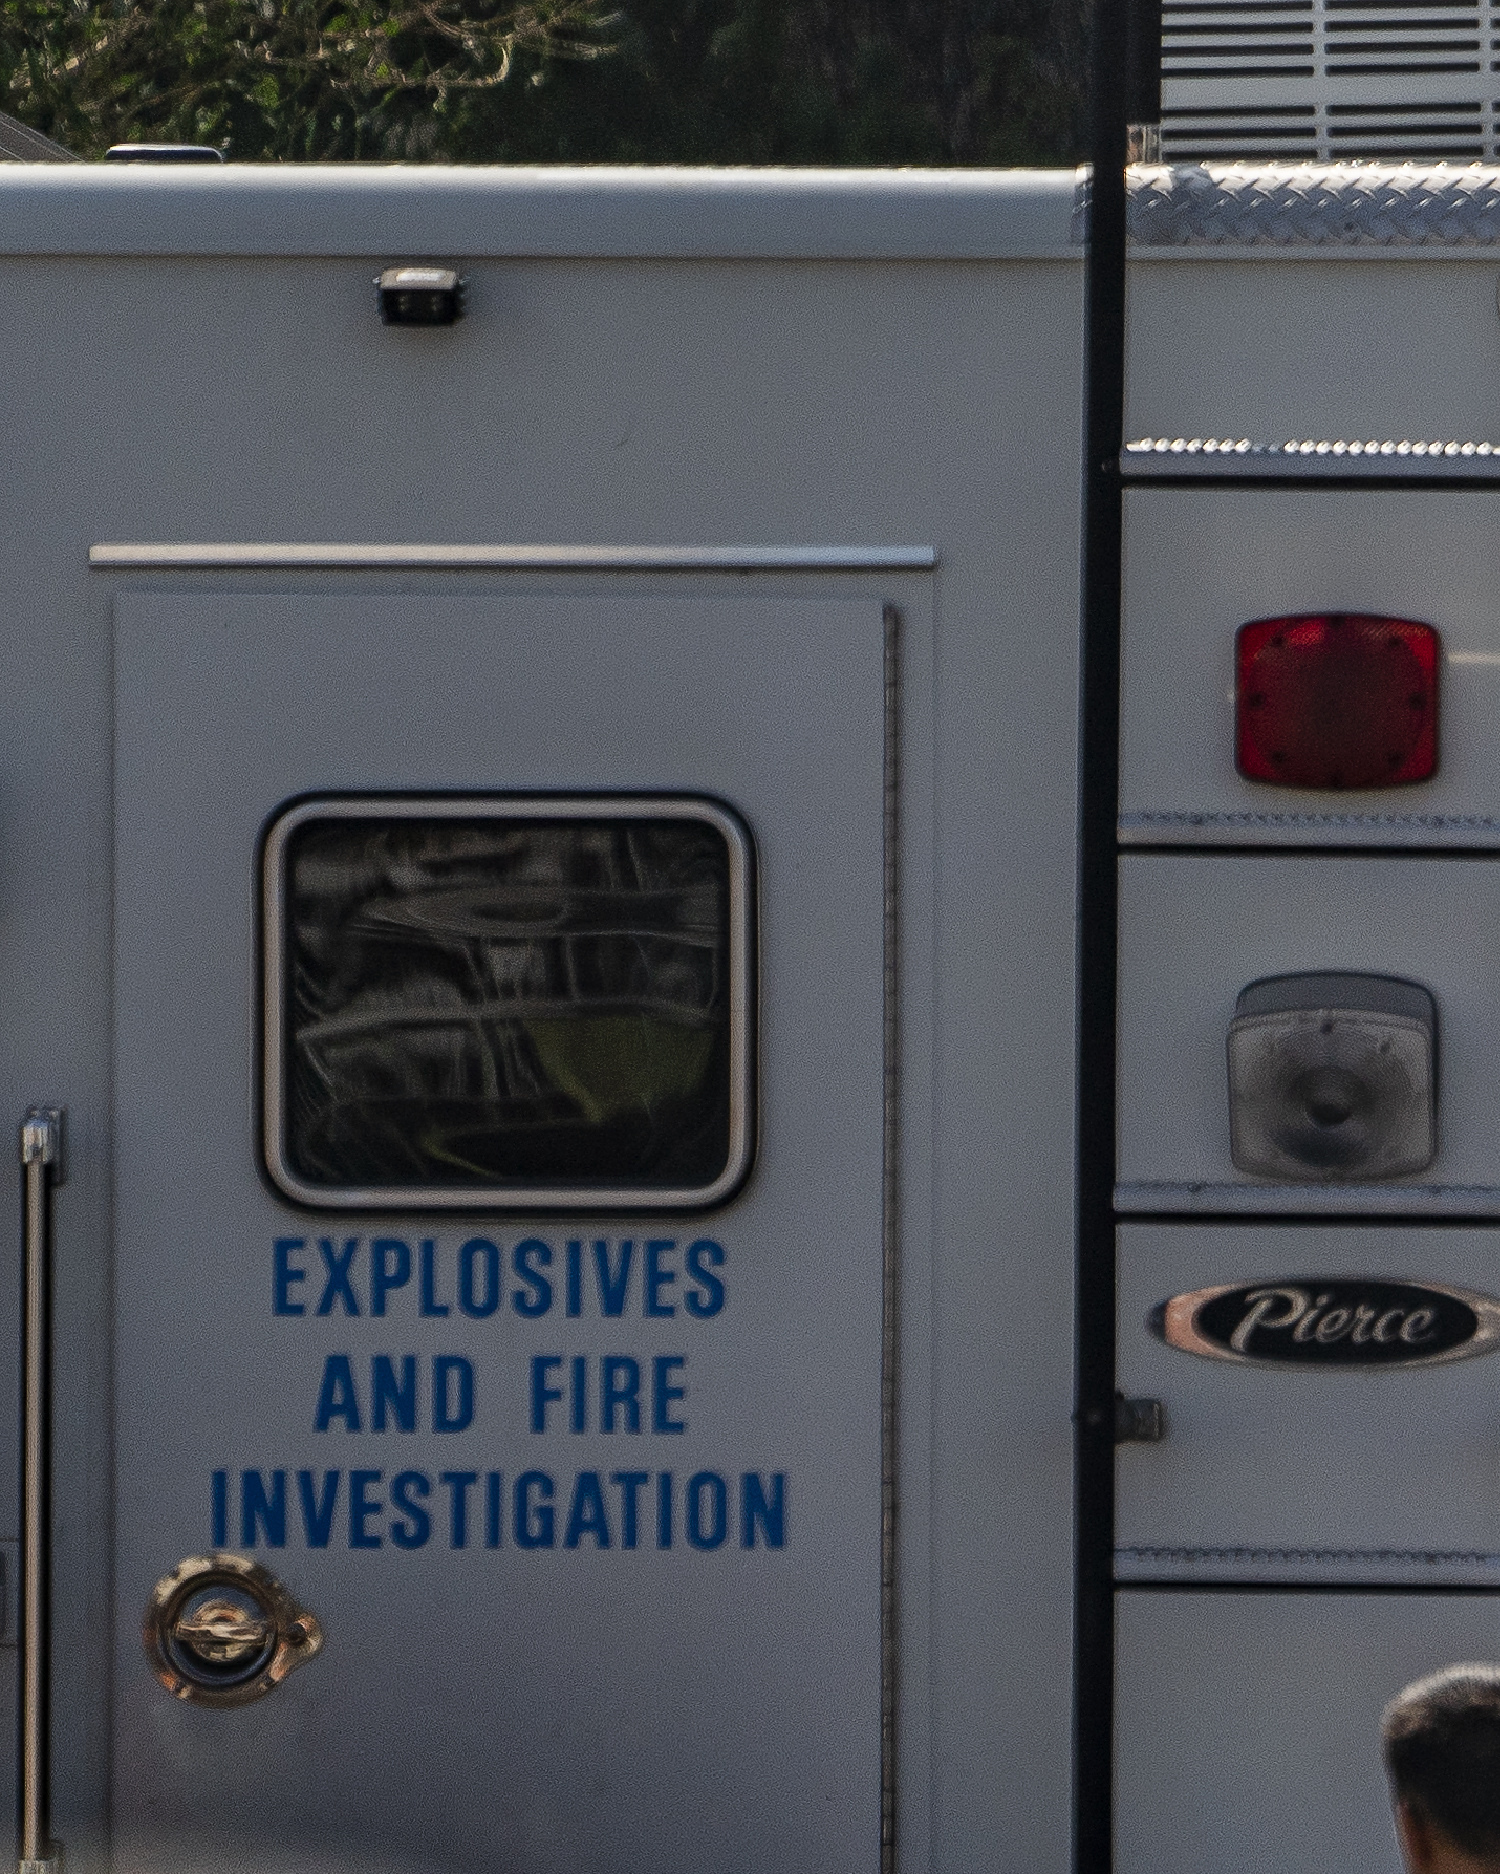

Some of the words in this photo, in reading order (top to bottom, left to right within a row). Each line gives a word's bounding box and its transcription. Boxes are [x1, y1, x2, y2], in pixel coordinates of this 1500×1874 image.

[271, 1236, 727, 1319] EXPLOSIVES
[1230, 1286, 1434, 1351] Pierce
[312, 1354, 476, 1435] AND
[530, 1354, 685, 1435] FIRE
[210, 1468, 787, 1551] INVESTIGATION
